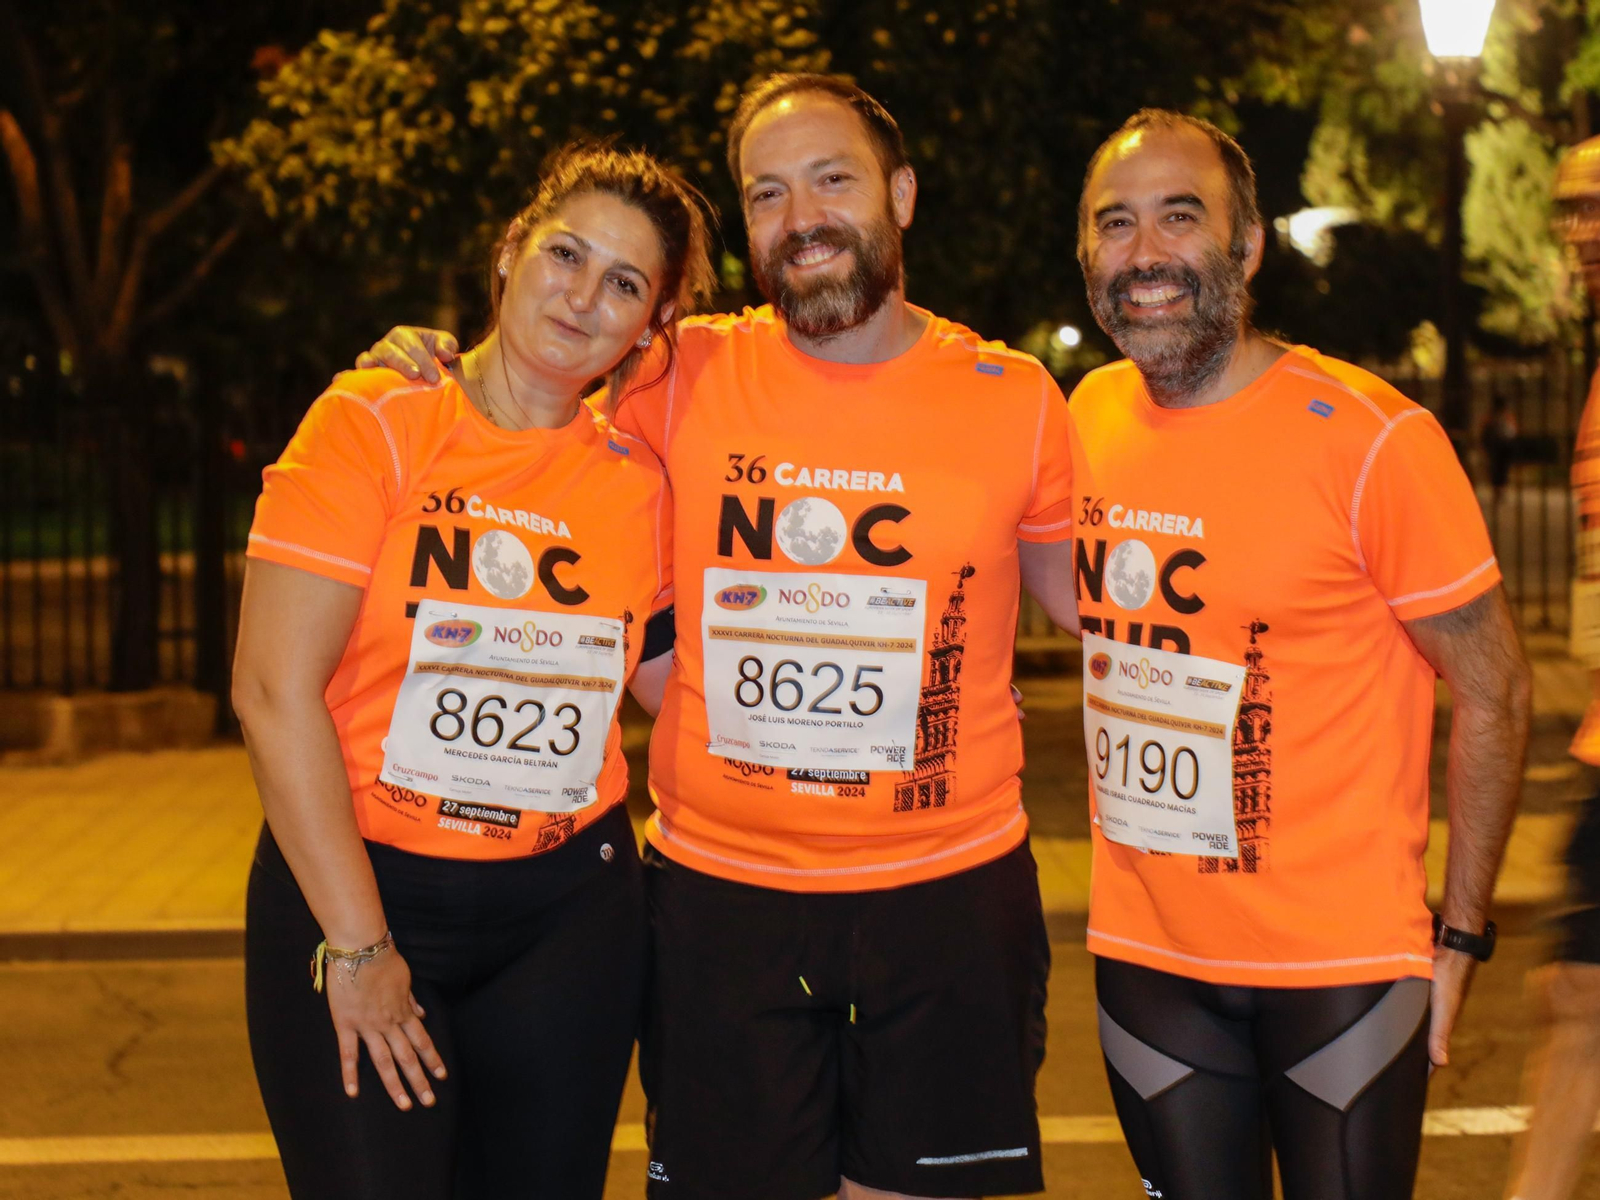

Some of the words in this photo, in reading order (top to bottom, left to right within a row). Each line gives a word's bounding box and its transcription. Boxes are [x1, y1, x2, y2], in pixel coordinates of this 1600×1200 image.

[725, 453, 767, 484] 36
[774, 462, 905, 492] CARRERA
[466, 494, 572, 539] CARRERA
[1078, 496, 1104, 526] 36
[1108, 504, 1204, 538] CARRERA
[734, 630, 764, 639] CARRERA
[765, 633, 804, 642] NOCTURNA
[805, 636, 819, 644] DEL
[820, 637, 875, 647] GUADALQUIVIR
[441, 665, 474, 675] CARRERA
[475, 669, 514, 680] NOCTURNA
[530, 676, 580, 686] GUADALQUIVIR
[734, 655, 884, 716] 8625
[429, 687, 582, 756] 8623
[748, 713, 766, 722] JOSÉ
[768, 716, 785, 724] LUIS
[787, 717, 823, 727] MORENO
[825, 720, 864, 729] PORTILLO
[1111, 706, 1136, 718] NOCTURNA
[1136, 712, 1147, 720] DEL
[1148, 714, 1192, 729] GUADALQUIVIR
[1208, 726, 1224, 735] 2024
[717, 734, 750, 749] Cruzcampo
[870, 745, 906, 754] POWER
[443, 747, 488, 761] MERCEDES
[490, 754, 521, 765] GARCÍA
[523, 758, 558, 769] BELTRÁN
[1095, 726, 1199, 800] 9190
[392, 763, 438, 782] Cruzcampo
[808, 768, 866, 781] septiembre
[561, 787, 588, 796] POWER
[790, 782, 835, 797] SEVILLA
[837, 786, 866, 798] 2024
[442, 800, 458, 813] 27
[459, 804, 517, 824] septiembre
[1110, 789, 1127, 801] ISRAEL
[1127, 795, 1166, 809] CUADRADO
[1166, 803, 1197, 815] MACÍAS
[438, 817, 481, 836] SEVILLA
[482, 825, 512, 840] 2024
[1192, 831, 1228, 842] POWER
